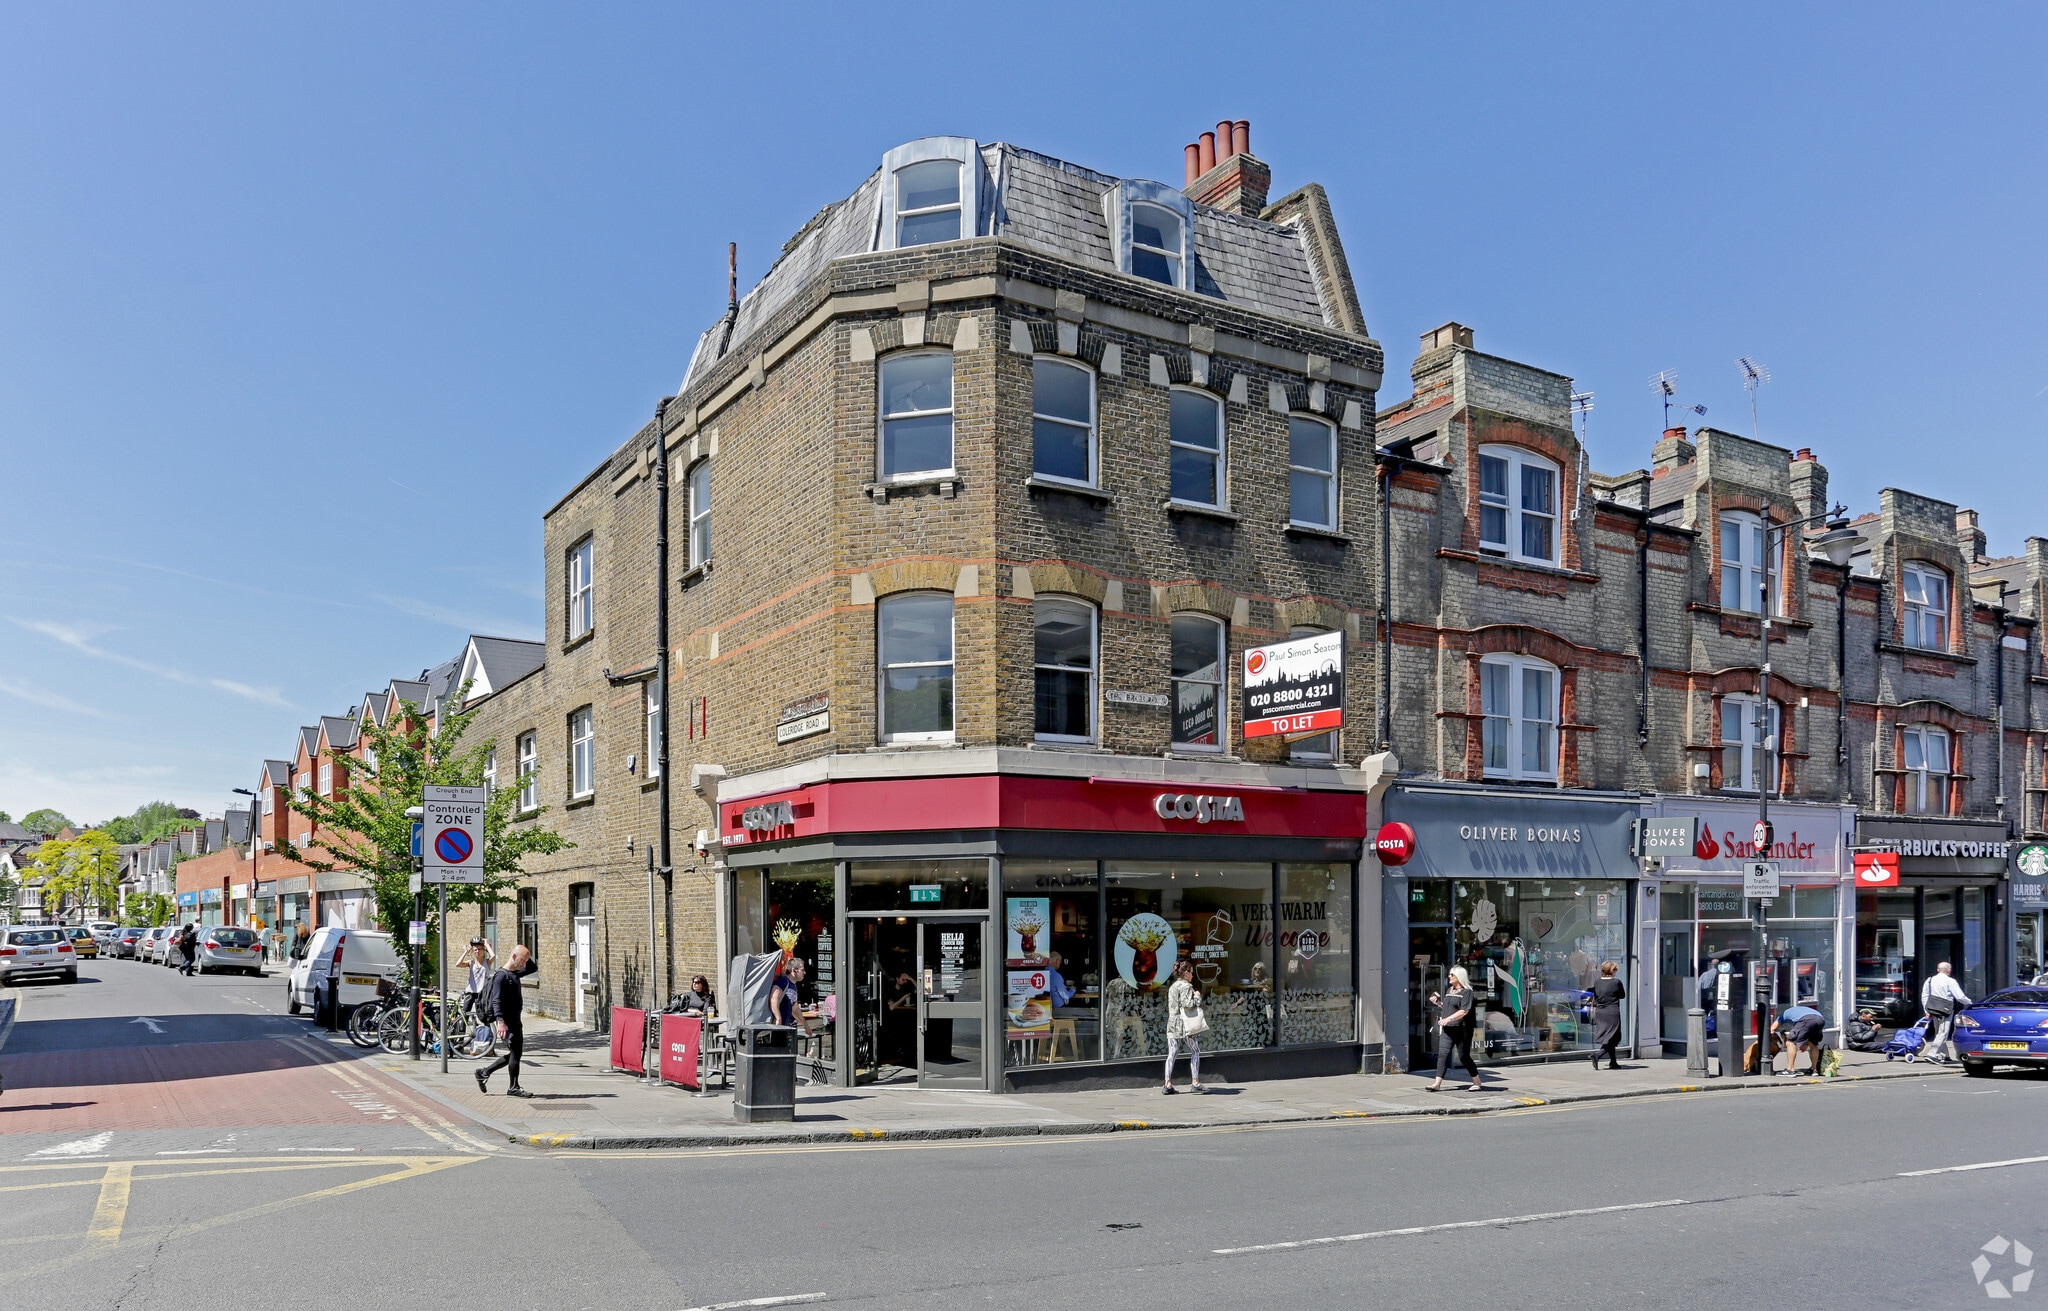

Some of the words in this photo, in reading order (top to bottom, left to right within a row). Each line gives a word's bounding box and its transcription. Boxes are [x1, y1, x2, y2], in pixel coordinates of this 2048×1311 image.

[1269, 651, 1286, 661] Paul
[1287, 648, 1311, 658] Simon
[1314, 643, 1341, 654] Seaton
[1250, 693, 1270, 707] 020
[1273, 688, 1302, 703] 8800
[1305, 683, 1333, 698] 4321
[1262, 700, 1321, 716] psscommercial.com
[779, 723, 803, 737] COLERIDGE
[806, 718, 819, 730] ROAD
[1271, 719, 1289, 733] TO
[1292, 716, 1314, 730] LET
[428, 804, 480, 814] Controlled
[1156, 793, 1245, 824] COSTA
[435, 814, 472, 825] ZONE
[742, 800, 795, 832] COSTA
[722, 835, 732, 845] EST.
[733, 834, 744, 843] 1971
[1460, 825, 1518, 841] OLIVER
[1527, 828, 1581, 843] BONAS
[1643, 828, 1686, 837] OLIVER
[1754, 829, 1764, 842] 20
[1378, 839, 1404, 849] COSTA
[1643, 838, 1685, 847] BONAS
[1723, 831, 1815, 859] Sanander
[1961, 842, 2008, 858] COFFEE
[2013, 884, 2041, 896] HARRIS
[1229, 904, 1238, 920] A
[1280, 902, 1326, 920] WARM
[941, 932, 964, 940] HELLO
[1035, 976, 1043, 987] £1
[1483, 1040, 1493, 1048] US
